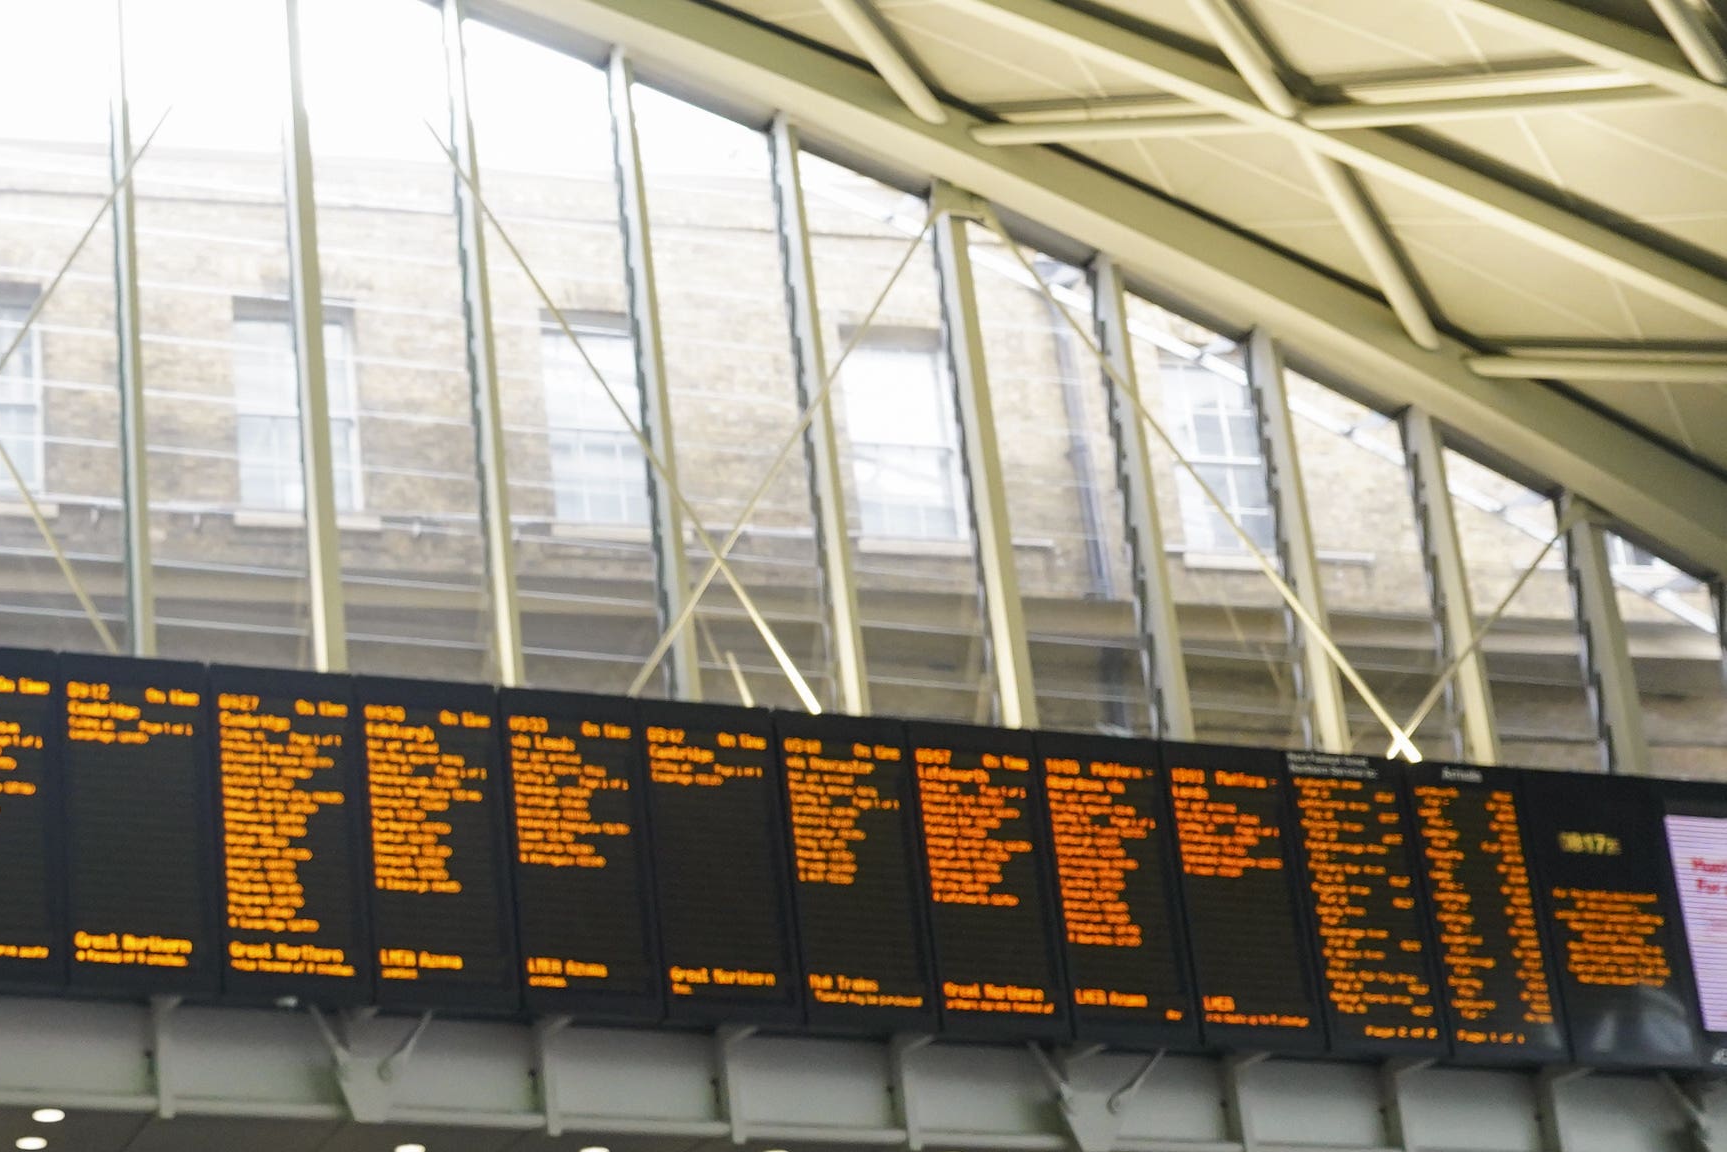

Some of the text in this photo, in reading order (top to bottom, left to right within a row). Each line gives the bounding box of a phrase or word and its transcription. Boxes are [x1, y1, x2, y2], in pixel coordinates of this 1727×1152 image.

[18, 678, 49, 694] time
[145, 689, 167, 703] On
[169, 690, 199, 706] time
[295, 700, 315, 714] On
[318, 702, 347, 716] time
[67, 700, 141, 720] Cambridge
[219, 711, 290, 732] Cambridge
[365, 722, 435, 743] Edinburgh
[649, 743, 714, 764] Cambridge
[74, 930, 192, 954] Great Northern
[229, 941, 344, 963] Great Northern
